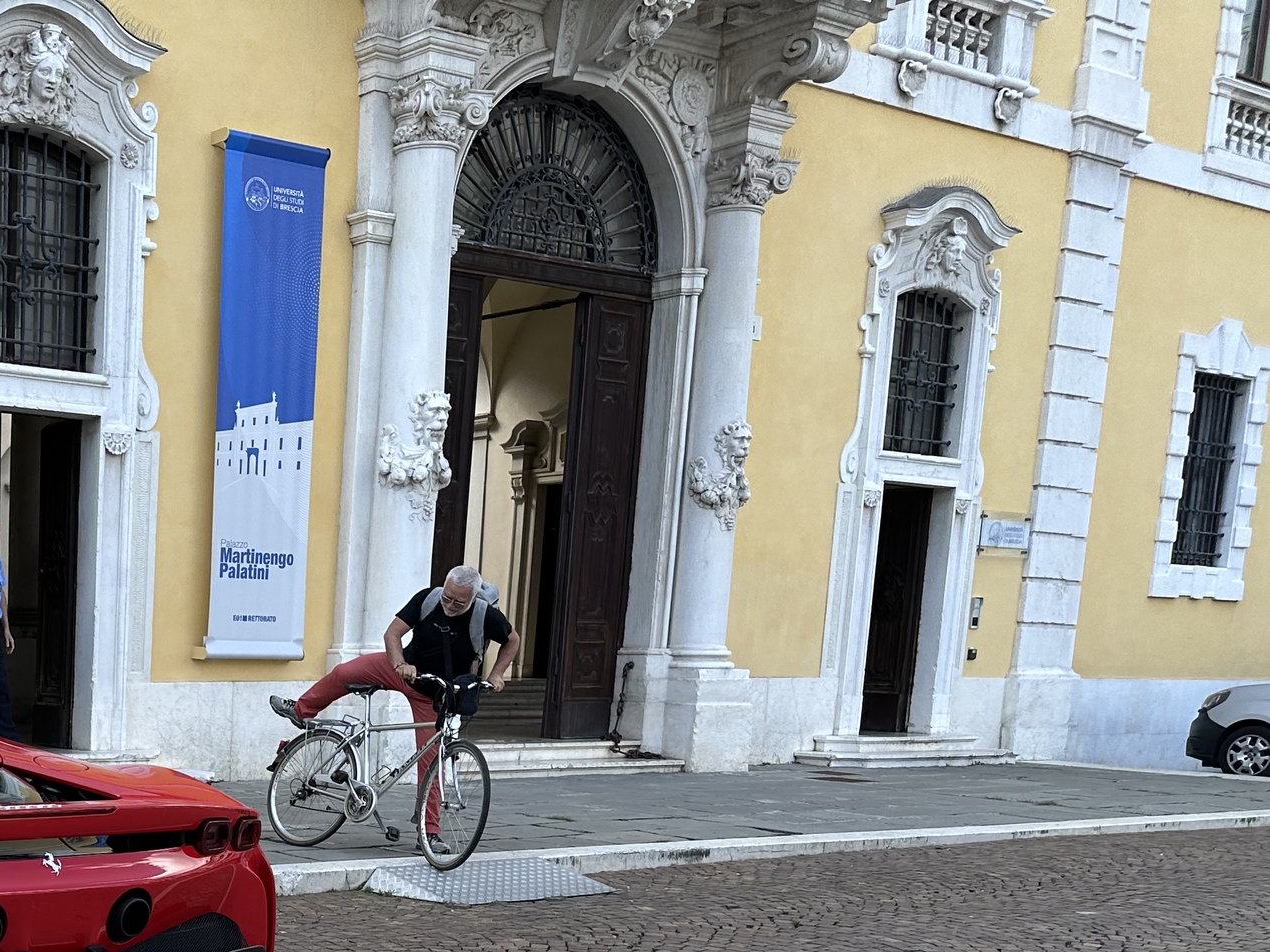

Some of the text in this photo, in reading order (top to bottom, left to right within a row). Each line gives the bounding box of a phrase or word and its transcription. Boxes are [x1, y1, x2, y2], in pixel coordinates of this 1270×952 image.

[273, 186, 304, 197] UNIVERSITÀ
[273, 194, 304, 205] DEGLI STUDI
[280, 204, 304, 214] BRESCIA
[220, 539, 248, 549] Palazzo
[220, 547, 294, 569] Martinengo
[219, 563, 269, 580] Palatini
